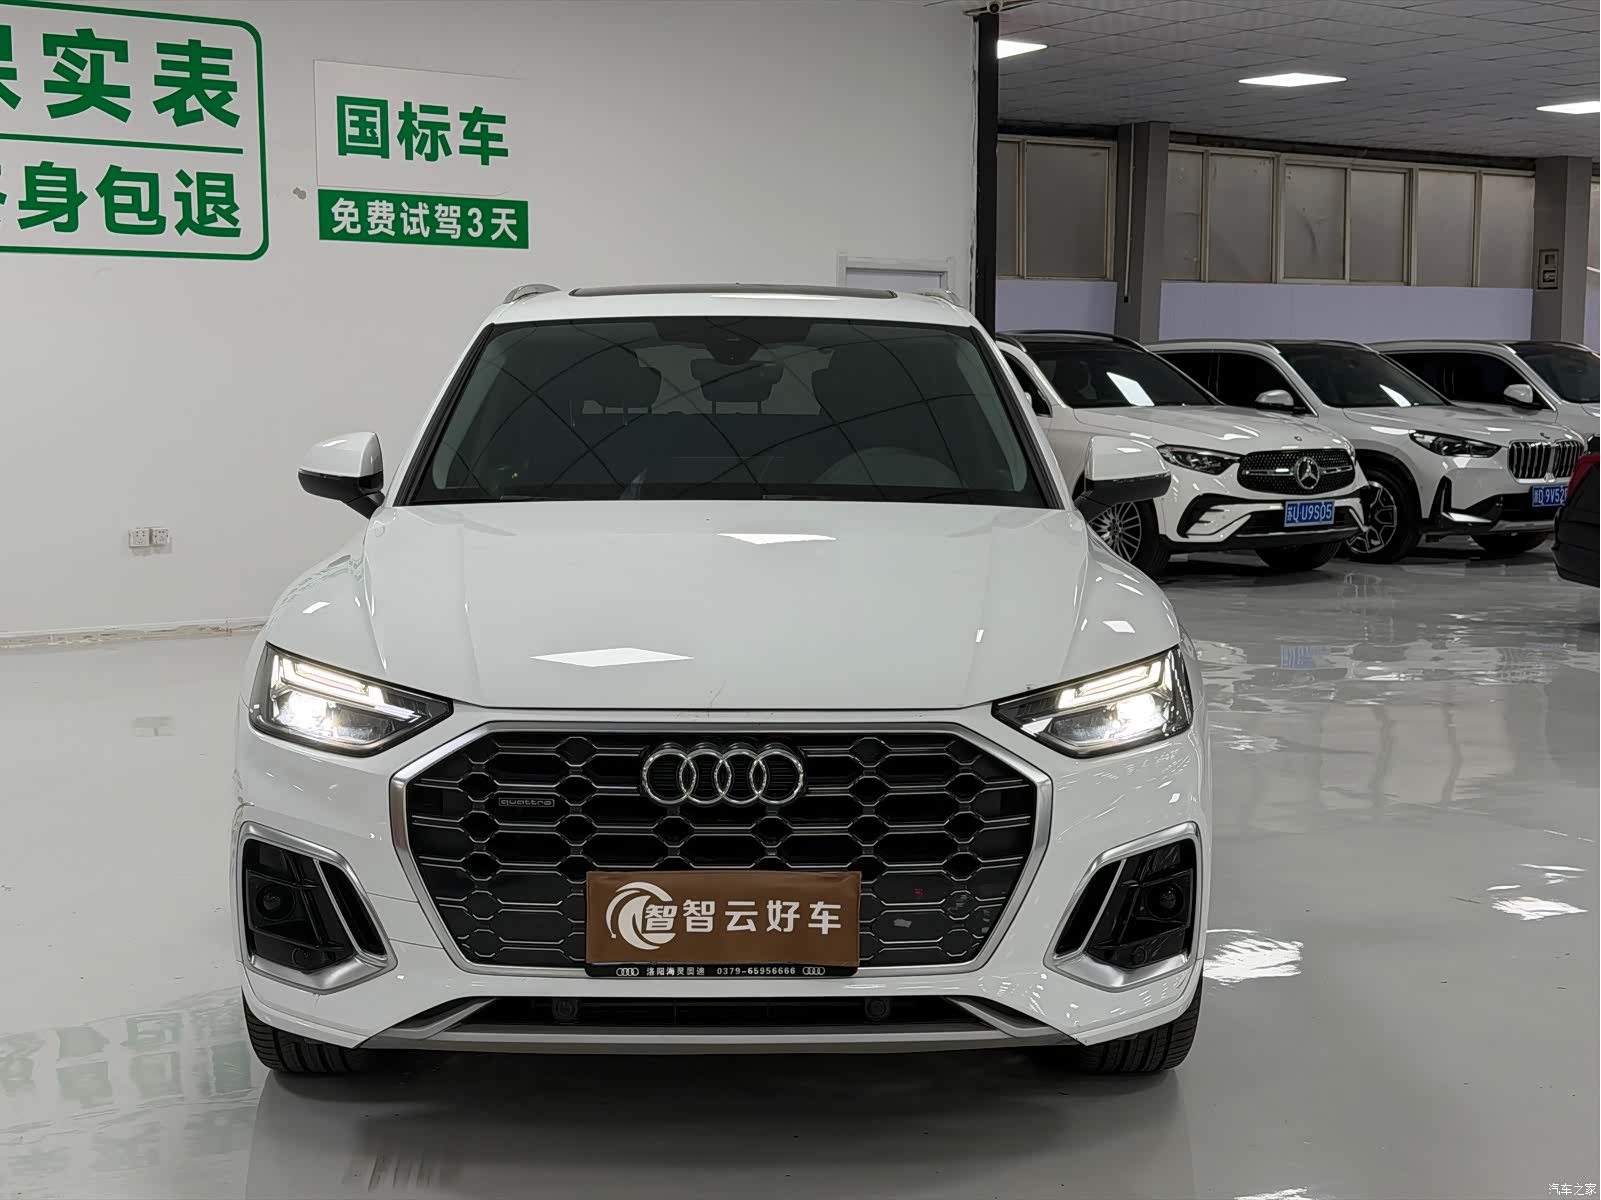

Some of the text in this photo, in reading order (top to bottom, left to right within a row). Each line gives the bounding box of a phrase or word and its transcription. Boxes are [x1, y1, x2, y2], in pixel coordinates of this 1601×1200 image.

[336, 95, 509, 166] 国标车
[0, 160, 241, 237] 身包退
[331, 197, 518, 242] 免费试驾3天
[500, 798, 553, 809] quattro
[716, 966, 796, 976] 0379-65956666
